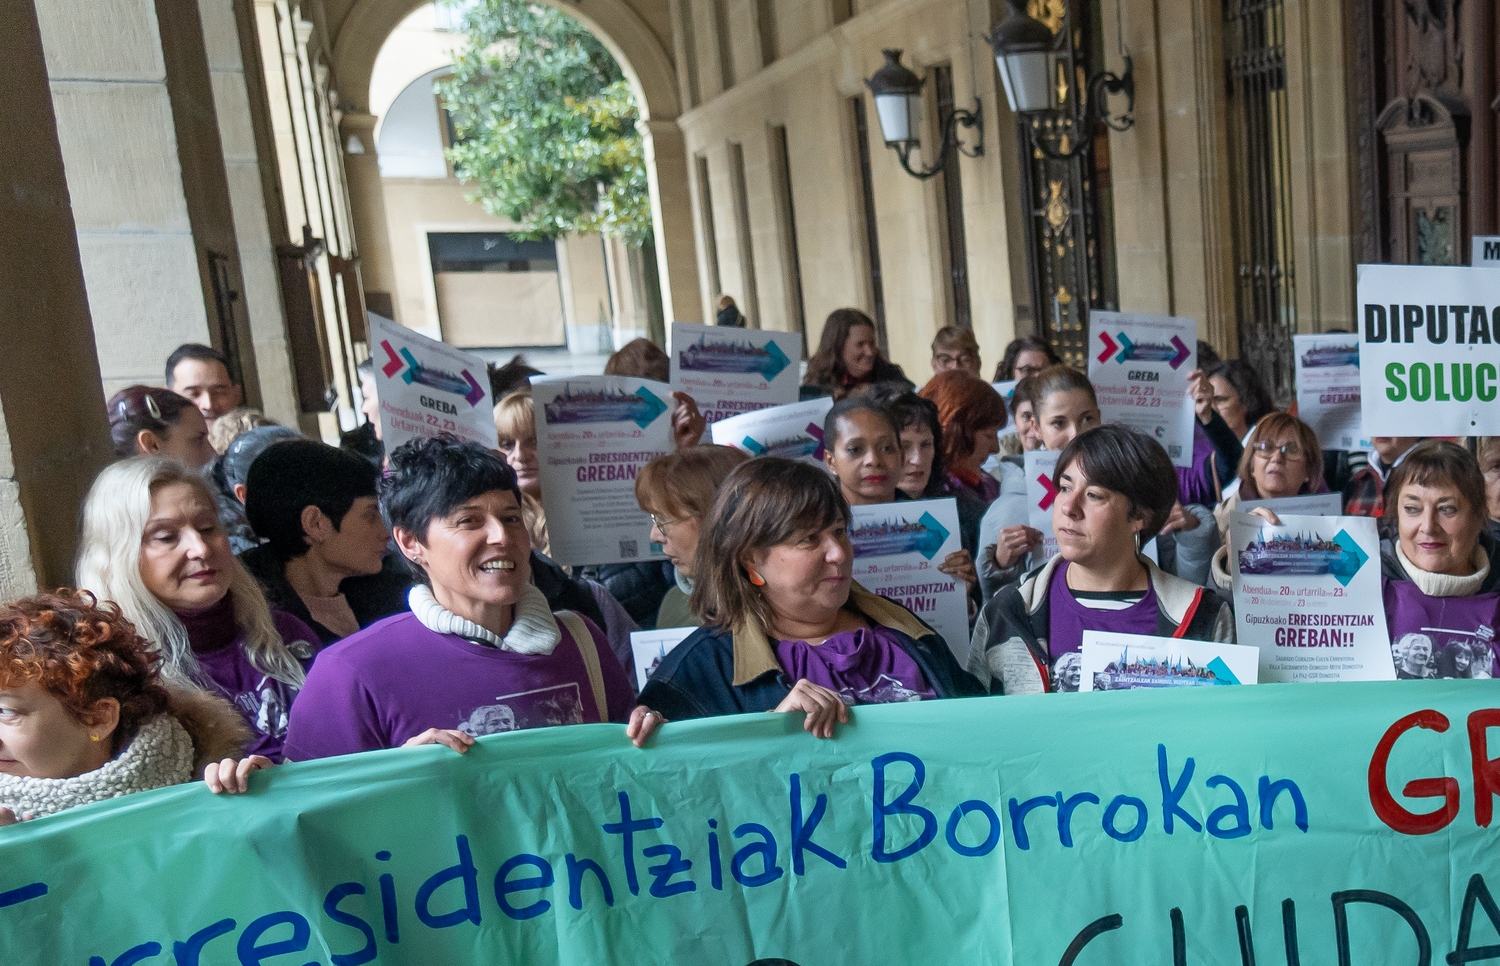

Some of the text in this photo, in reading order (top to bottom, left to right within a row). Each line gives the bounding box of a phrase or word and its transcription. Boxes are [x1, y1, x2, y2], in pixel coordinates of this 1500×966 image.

[1128, 370, 1160, 382] GREBA
[420, 395, 458, 416] GREBA
[875, 582, 956, 596] ERRESIDENTZIAK
[1245, 613, 1375, 626] Gipuzkoako ERRESIDENTZIAK
[1275, 627, 1355, 648] GREBAN!!
[872, 743, 1308, 866] Borrokan
